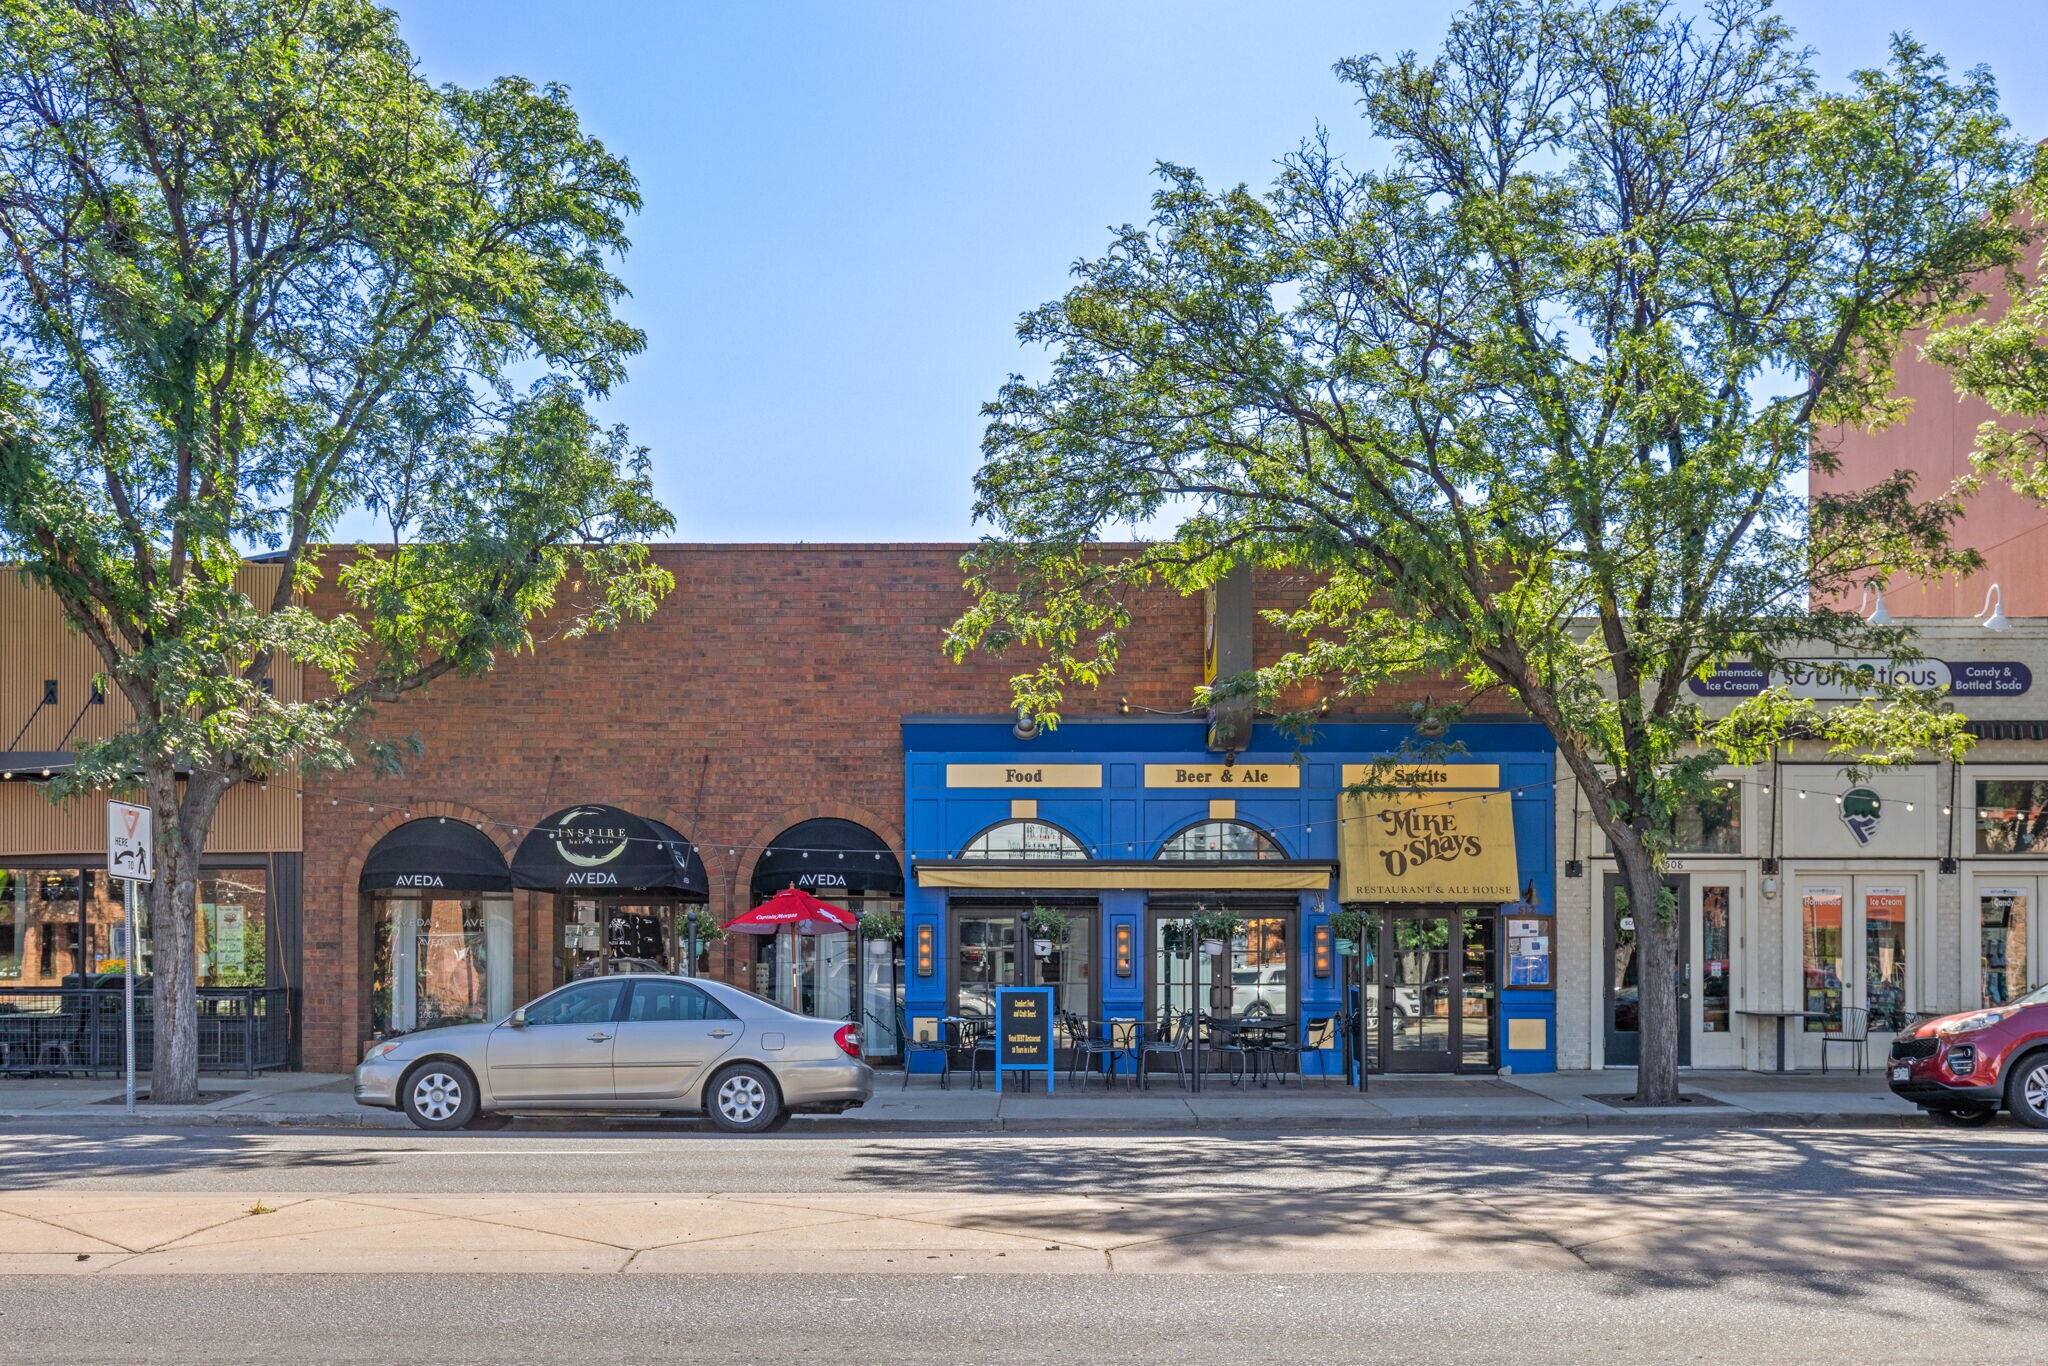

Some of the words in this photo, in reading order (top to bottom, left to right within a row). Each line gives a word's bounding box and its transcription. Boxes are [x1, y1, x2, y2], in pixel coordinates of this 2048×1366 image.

[1966, 668, 2001, 679] Candy
[2004, 668, 2011, 676] &
[1706, 681, 1721, 690] Ice
[1724, 681, 1759, 690] Cream
[1956, 680, 1992, 690] Bottled
[1995, 680, 2022, 690] Soda
[1006, 769, 1042, 783] Food
[1176, 769, 1212, 783] Beer
[1221, 769, 1233, 783] &
[1243, 769, 1269, 783] Ale
[1395, 769, 1447, 786] Spirits
[558, 828, 626, 837] INSPIRE
[115, 837, 128, 847] HERE
[128, 860, 134, 869] TO
[395, 875, 444, 887] AVEDA
[565, 872, 618, 885] AVEDA
[798, 874, 847, 886] AVEDA
[1356, 886, 1432, 894] RESTAURANT
[1436, 886, 1444, 894] &
[1448, 886, 1469, 894] ALE
[1473, 886, 1512, 894] HOUSE
